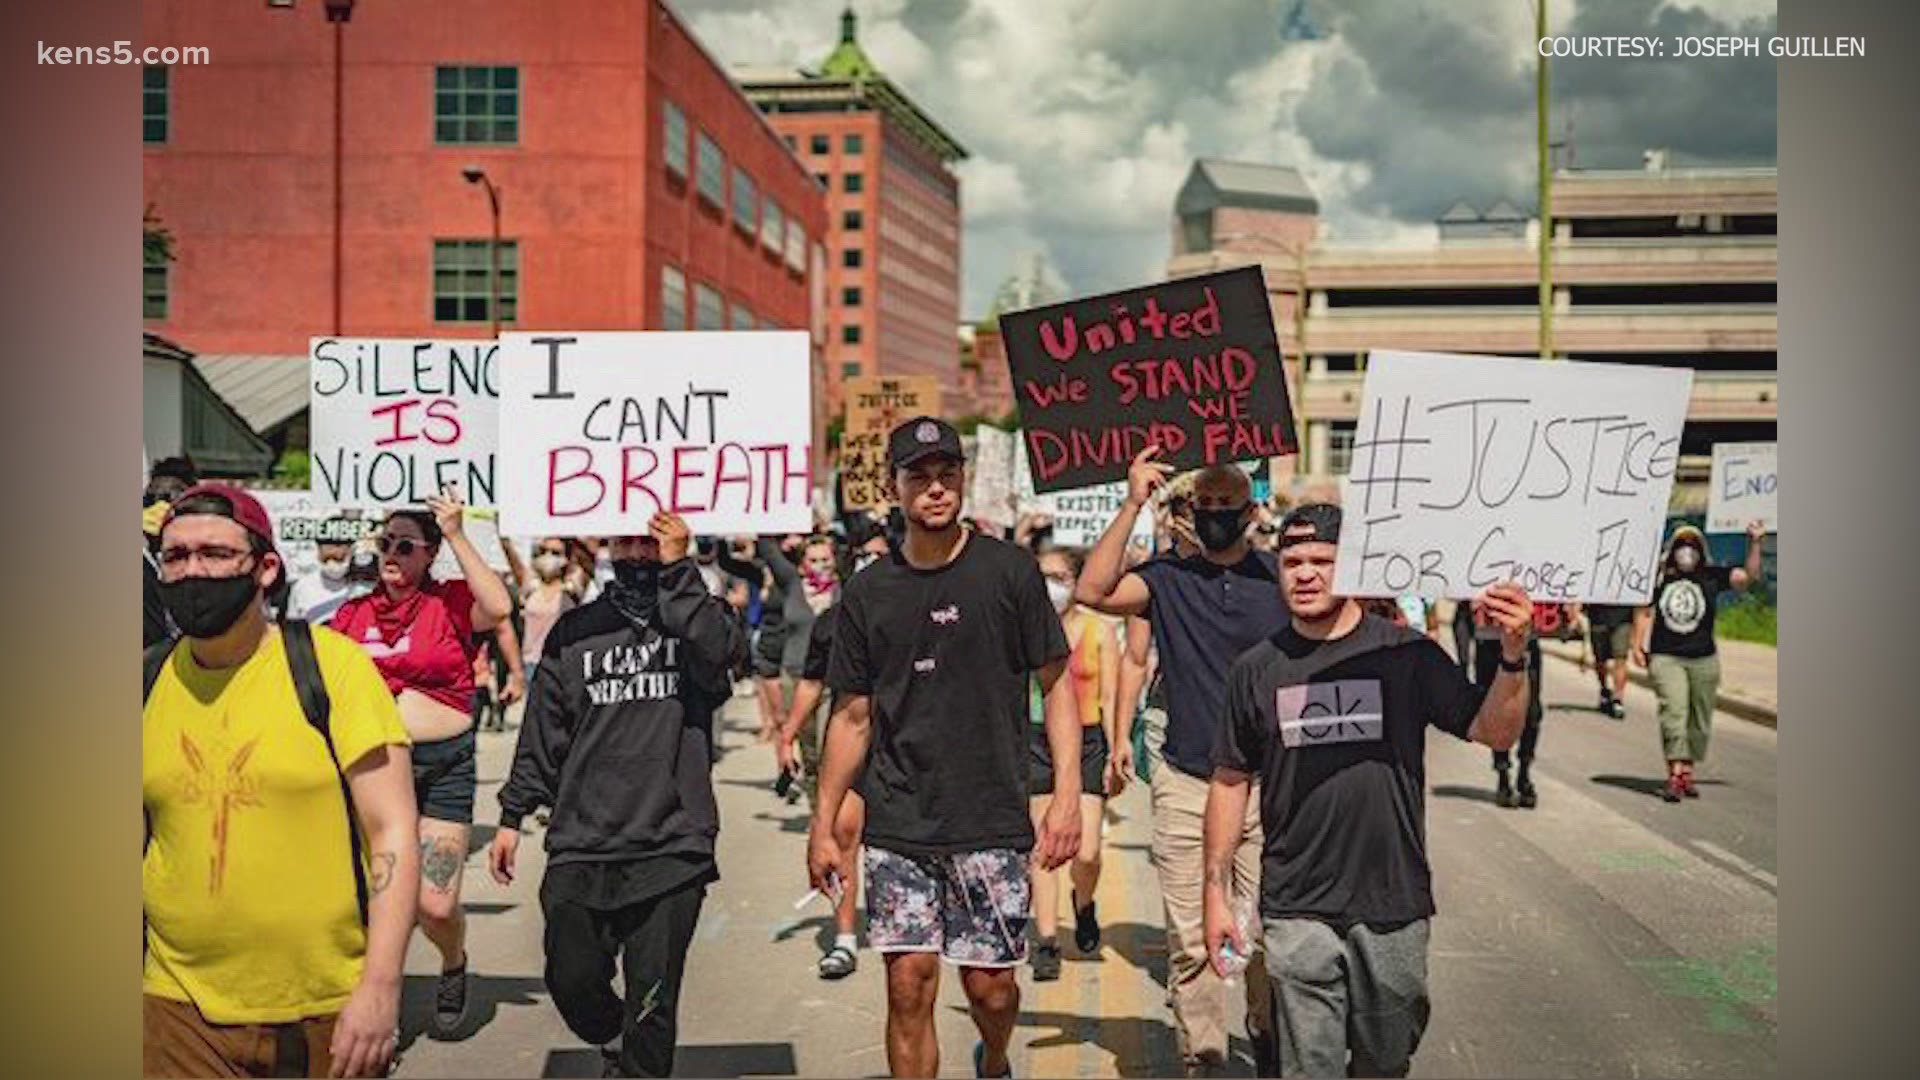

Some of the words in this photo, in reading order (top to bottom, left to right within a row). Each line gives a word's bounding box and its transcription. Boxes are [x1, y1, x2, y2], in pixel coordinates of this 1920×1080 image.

[1038, 285, 1222, 361] United
[530, 337, 578, 399] I
[1110, 347, 1257, 405] STAND
[372, 399, 462, 446] IS
[1188, 390, 1250, 421] WE
[1203, 421, 1297, 465] FALL
[1350, 395, 1679, 515] #JUSTICE
[548, 442, 814, 518] BREATH
[1358, 514, 1449, 591] FOR
